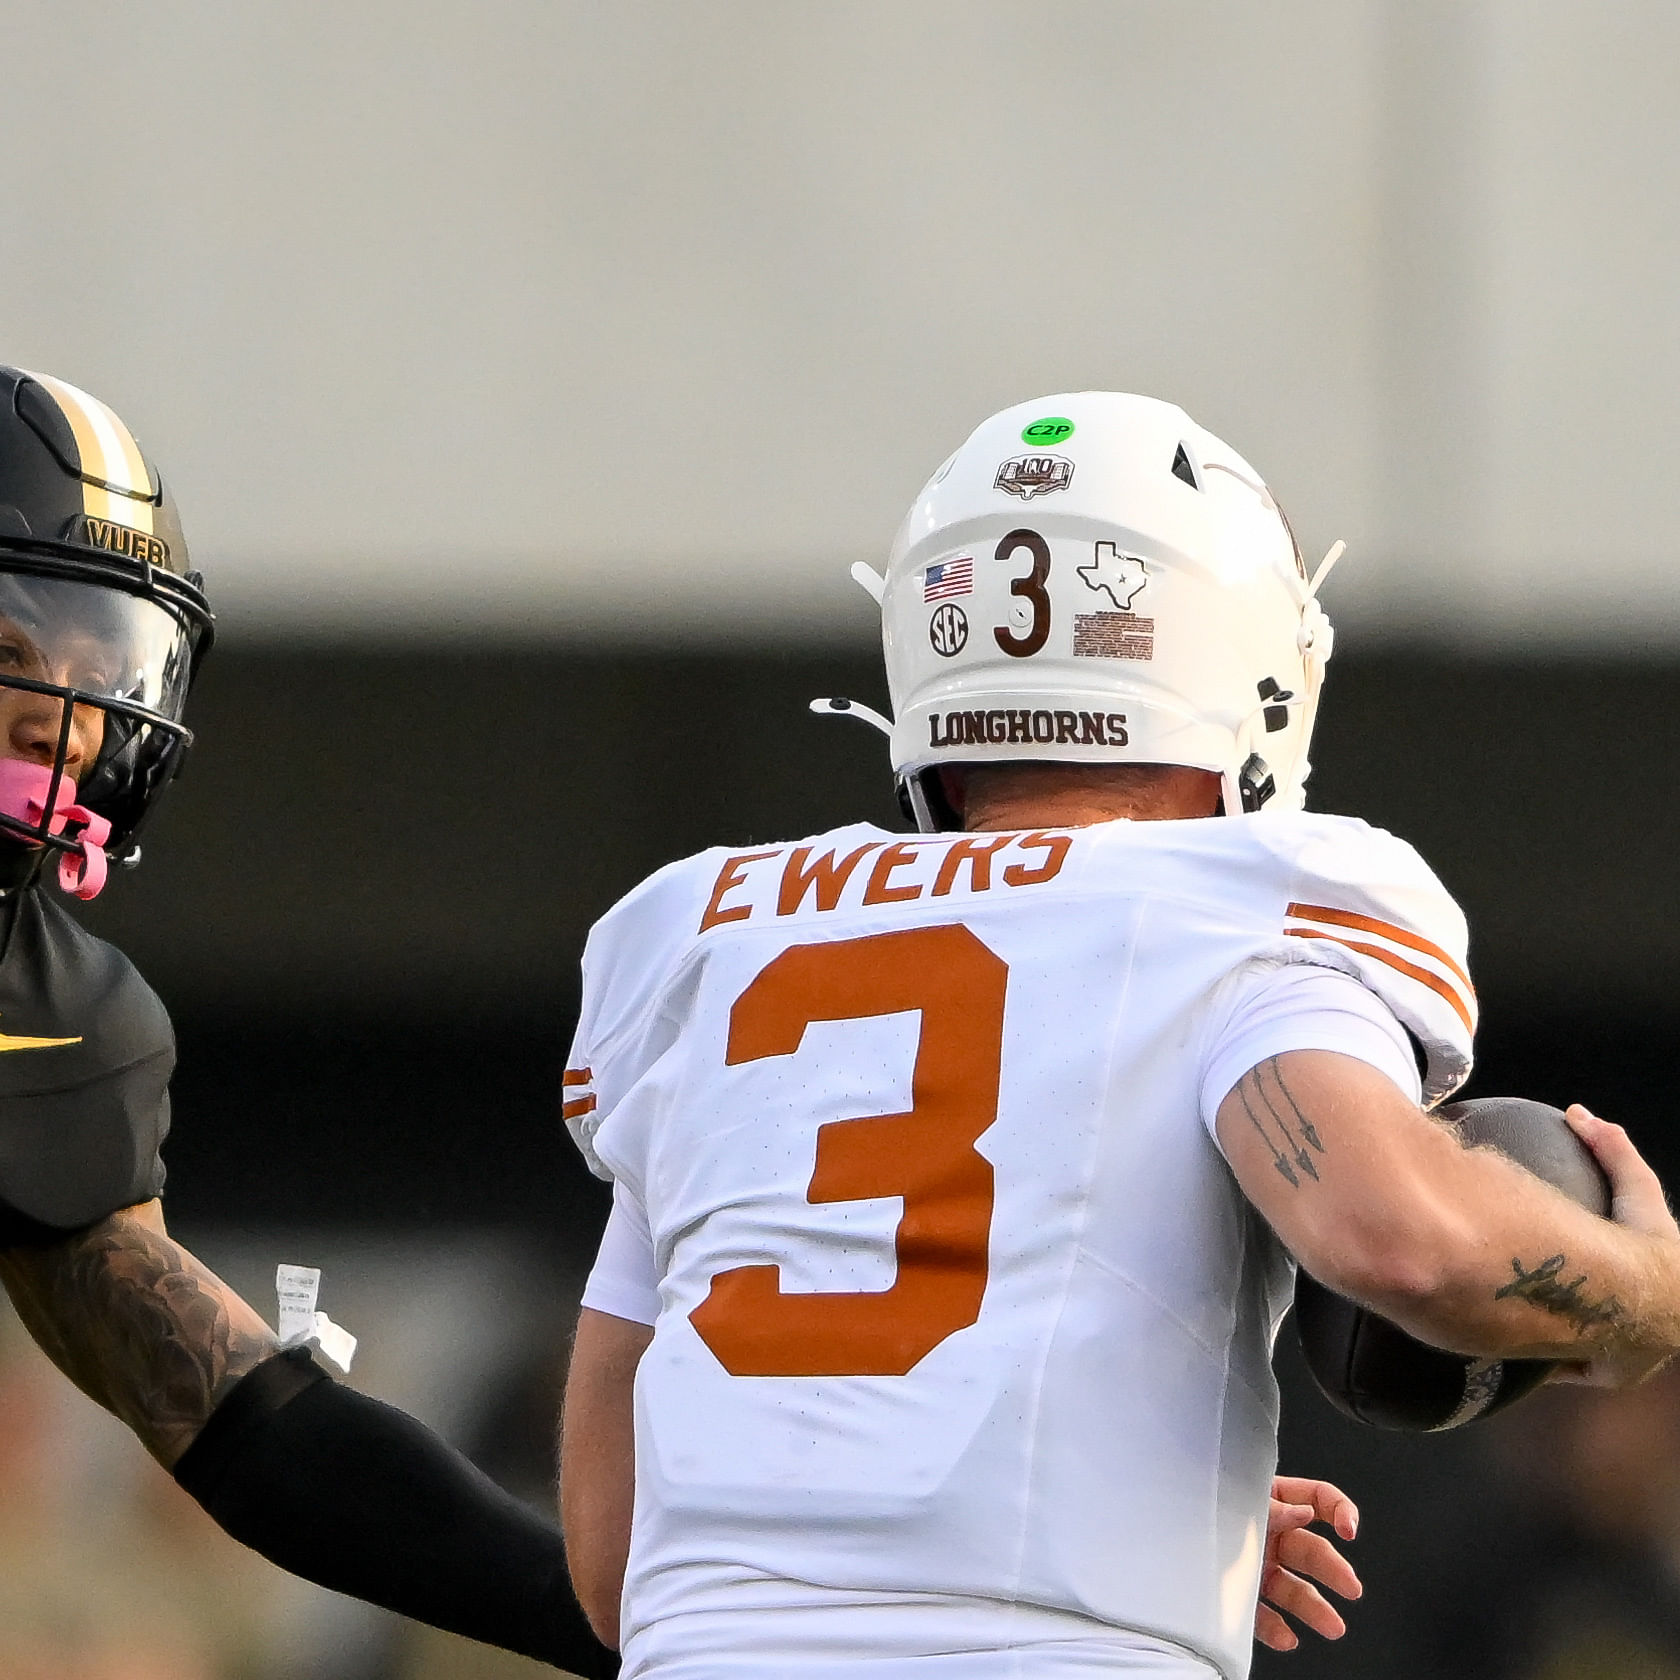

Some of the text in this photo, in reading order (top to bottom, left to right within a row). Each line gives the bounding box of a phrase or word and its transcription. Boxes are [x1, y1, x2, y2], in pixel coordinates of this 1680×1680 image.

[1026, 424, 1070, 436] C2P
[932, 604, 968, 656] SEC
[994, 528, 1051, 658] 3
[929, 710, 1129, 747] LONGHORNS
[698, 831, 1074, 935] EWERS
[689, 922, 1010, 1377] 3
